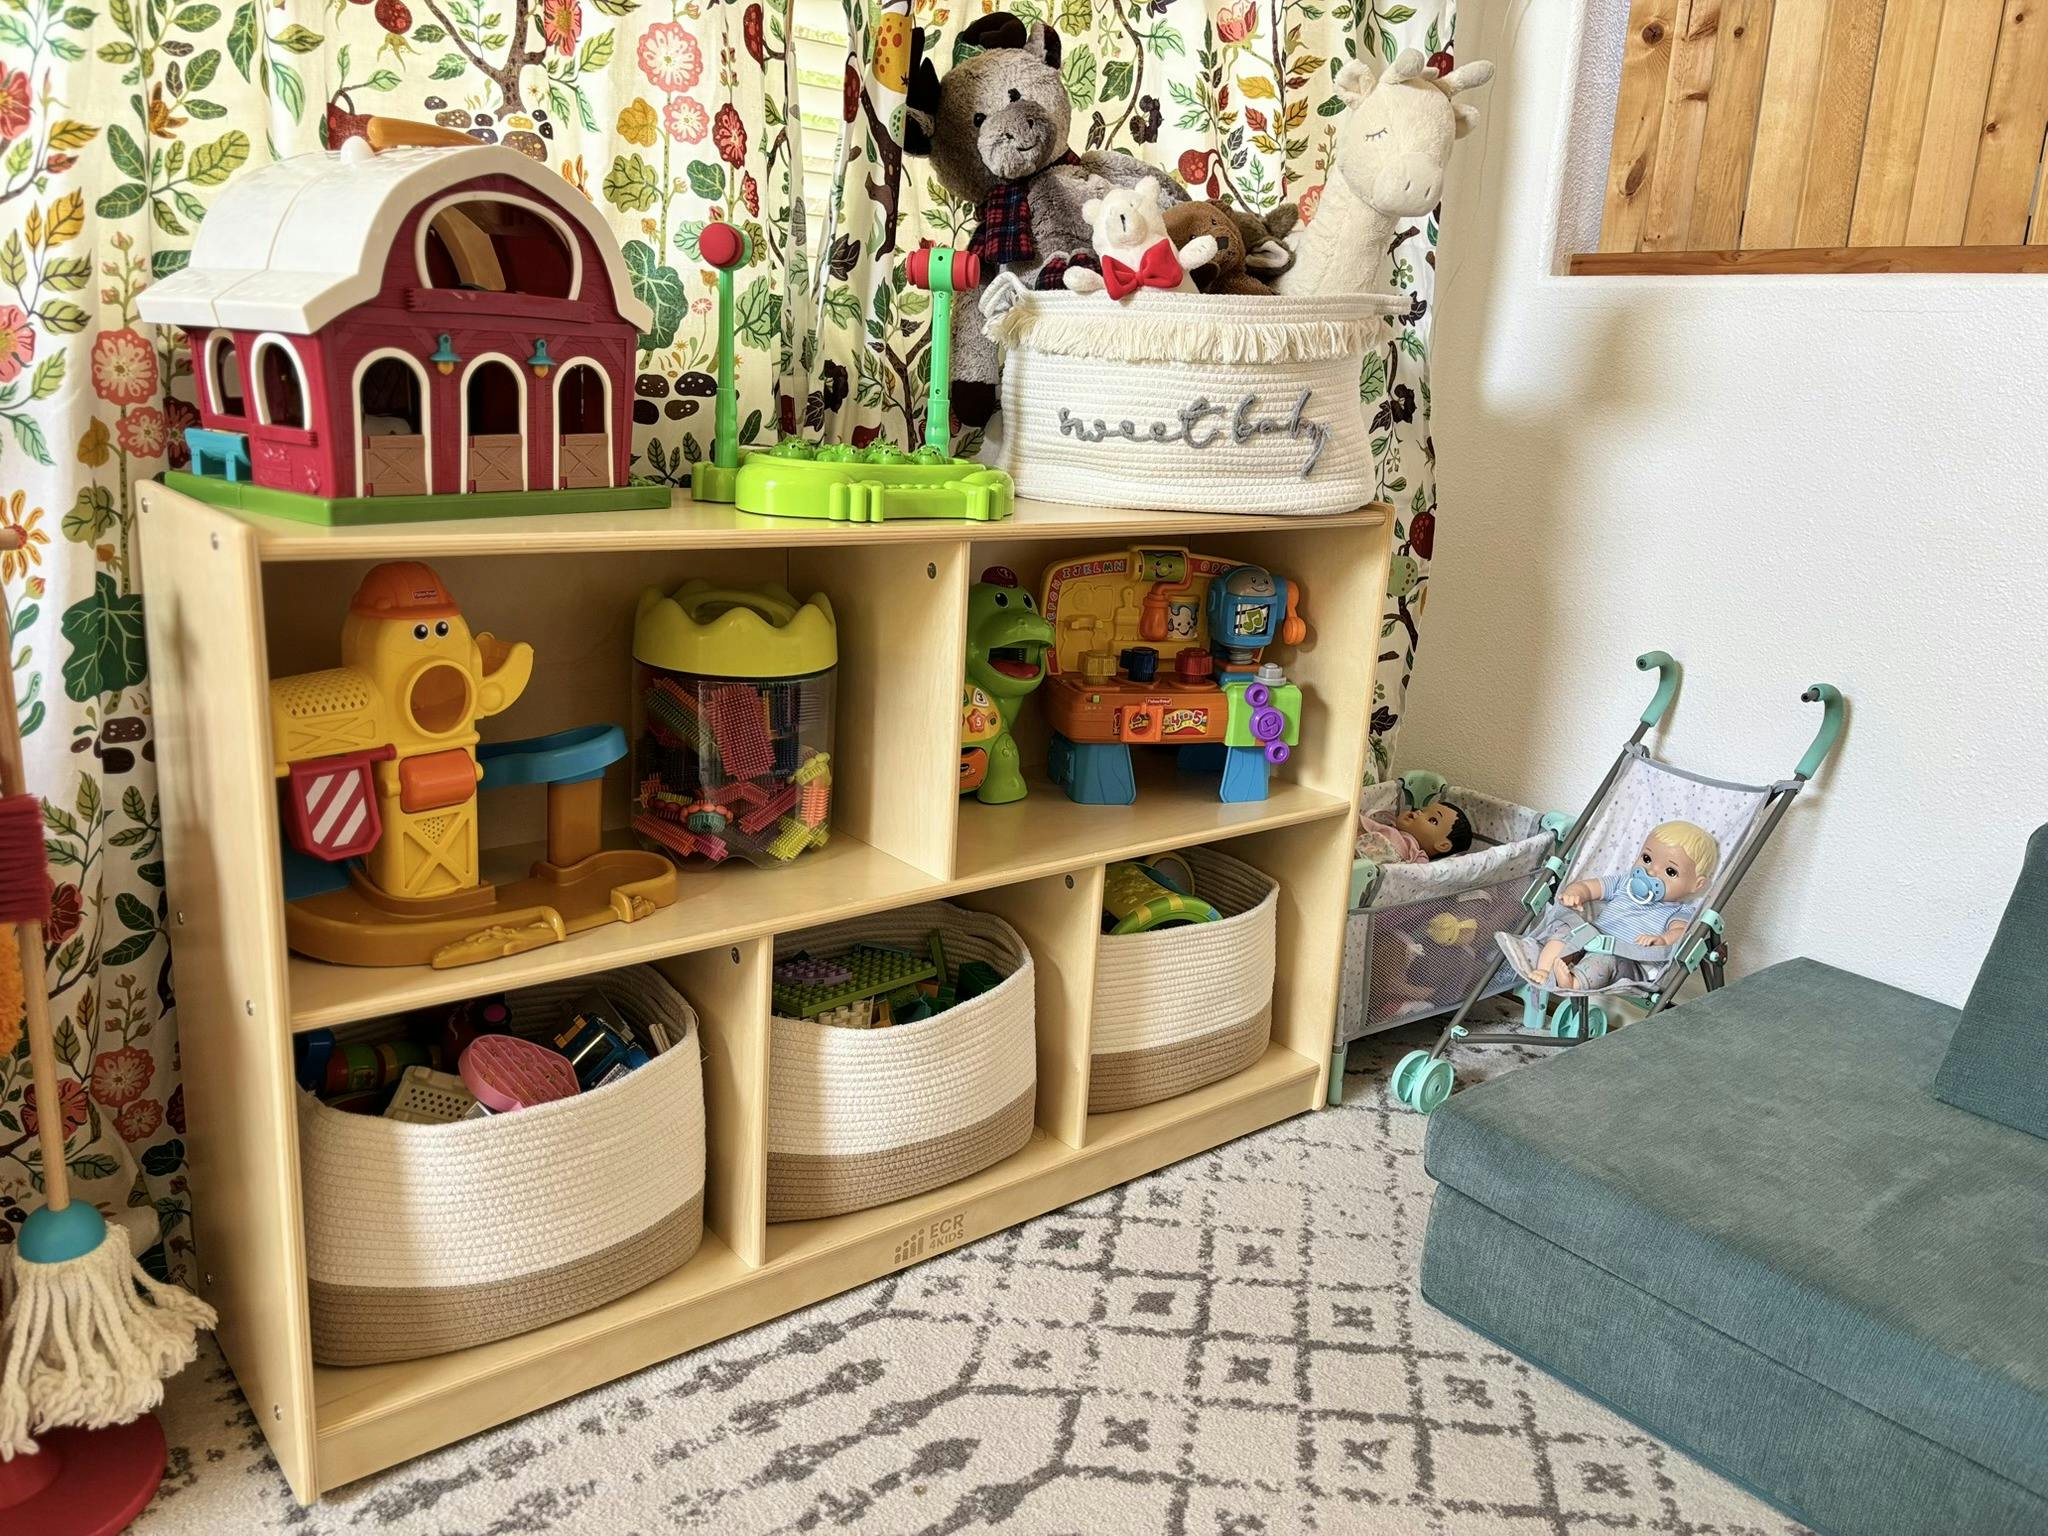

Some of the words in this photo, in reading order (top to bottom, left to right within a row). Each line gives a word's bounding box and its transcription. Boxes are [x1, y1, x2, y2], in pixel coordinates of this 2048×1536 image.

[1232, 387, 1333, 480] baby
[929, 1214, 964, 1239] ECR
[928, 1229, 964, 1250] 4KIDS
